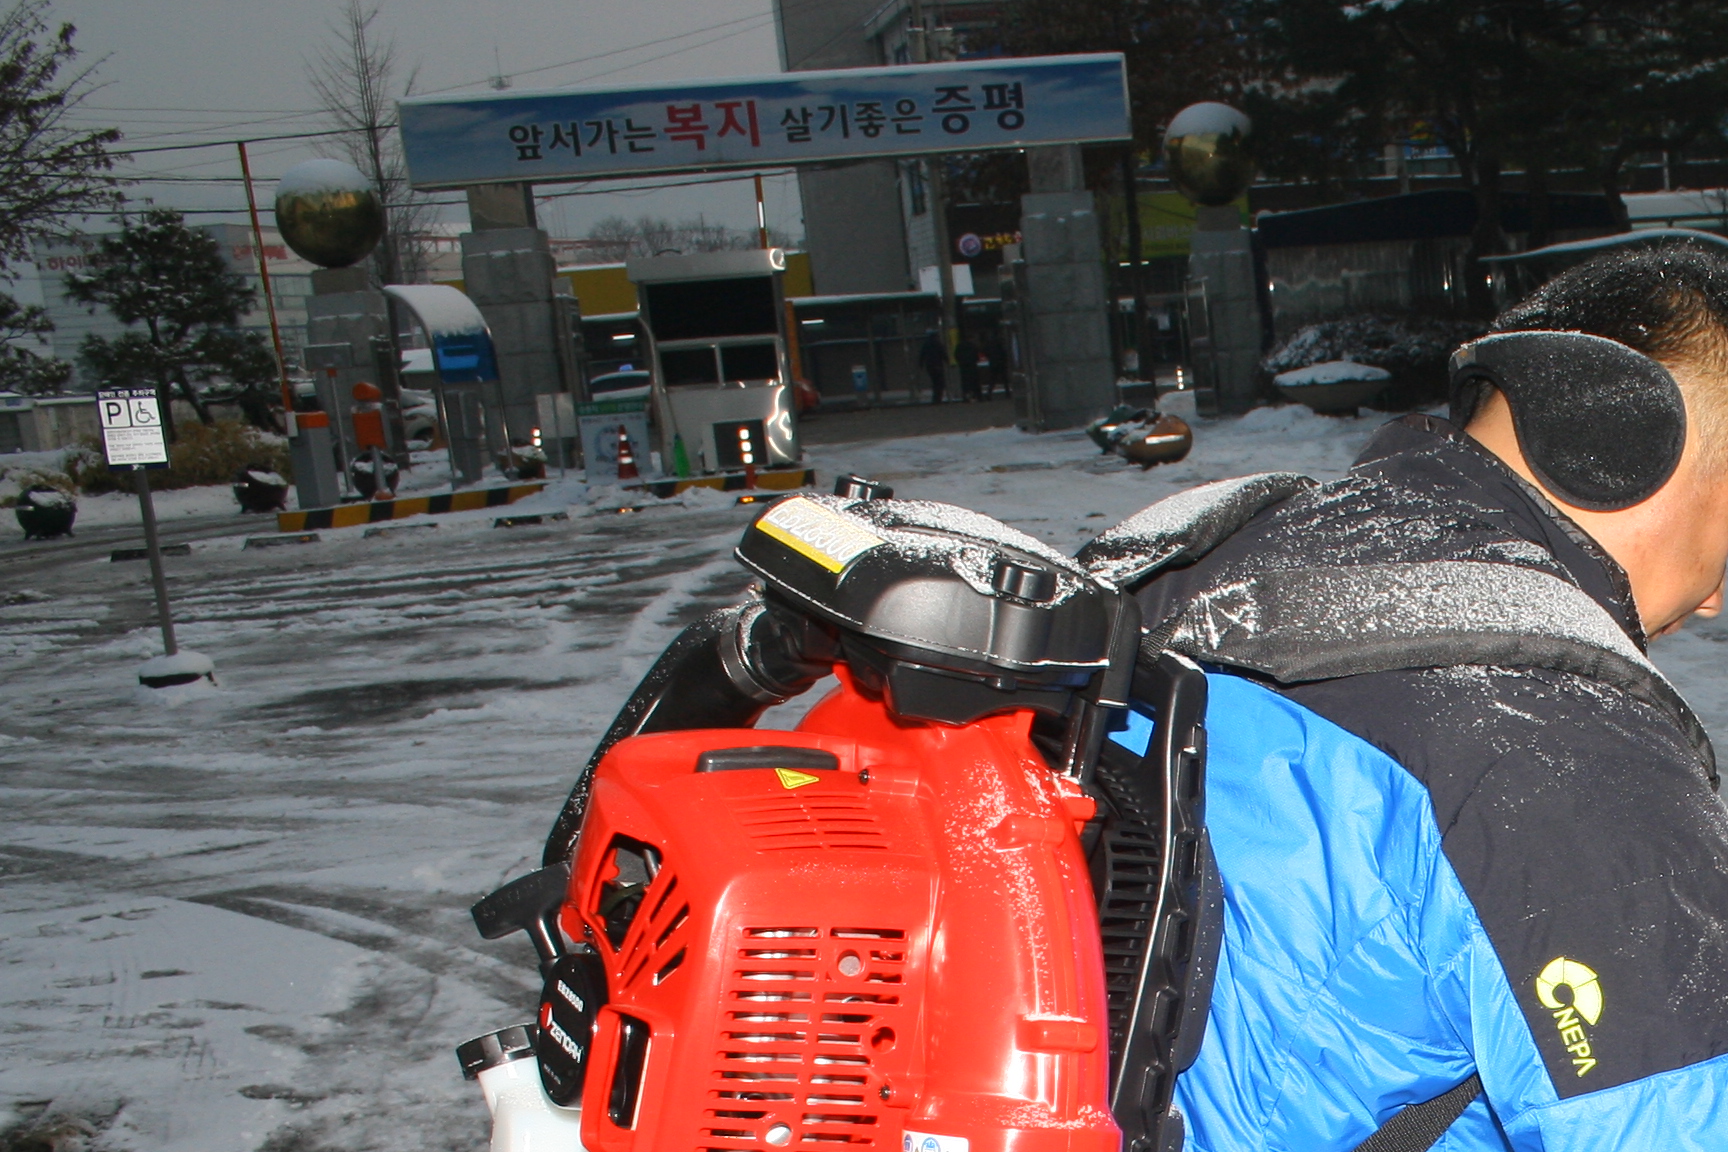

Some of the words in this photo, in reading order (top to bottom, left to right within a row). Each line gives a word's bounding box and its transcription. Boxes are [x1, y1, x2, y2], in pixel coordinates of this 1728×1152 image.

[508, 118, 657, 161] 앞서가는
[663, 99, 761, 150] 복지
[780, 99, 924, 143] 살기좋은
[931, 82, 1025, 135] 증평
[106, 402, 121, 425] P
[1553, 1006, 1597, 1077] NEPA
